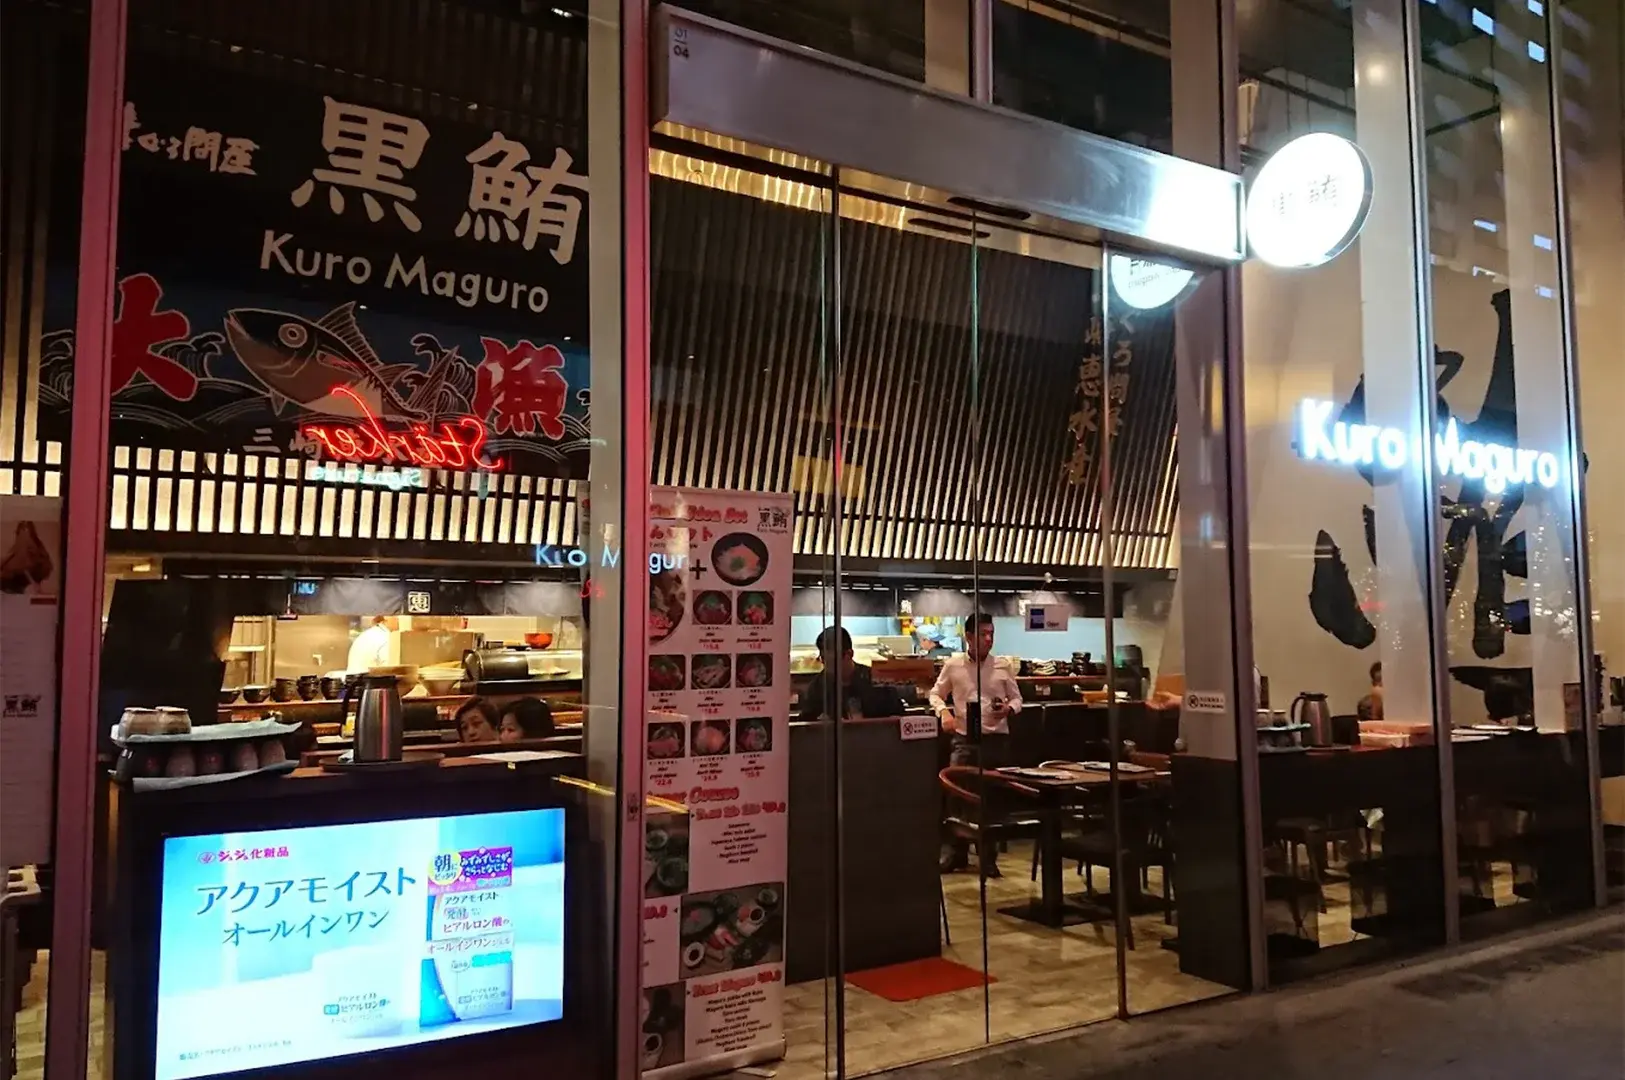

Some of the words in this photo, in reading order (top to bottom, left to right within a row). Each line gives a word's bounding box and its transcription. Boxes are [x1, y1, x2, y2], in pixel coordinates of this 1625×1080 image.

[291, 96, 589, 265] 黒鮪
[260, 229, 372, 286] Kuro
[383, 252, 550, 313] Maguro
[1299, 398, 1408, 469] Kuro
[1411, 414, 1560, 494] Maguro
[197, 866, 417, 916] アクアモイスト
[222, 909, 391, 946] オールインワン
